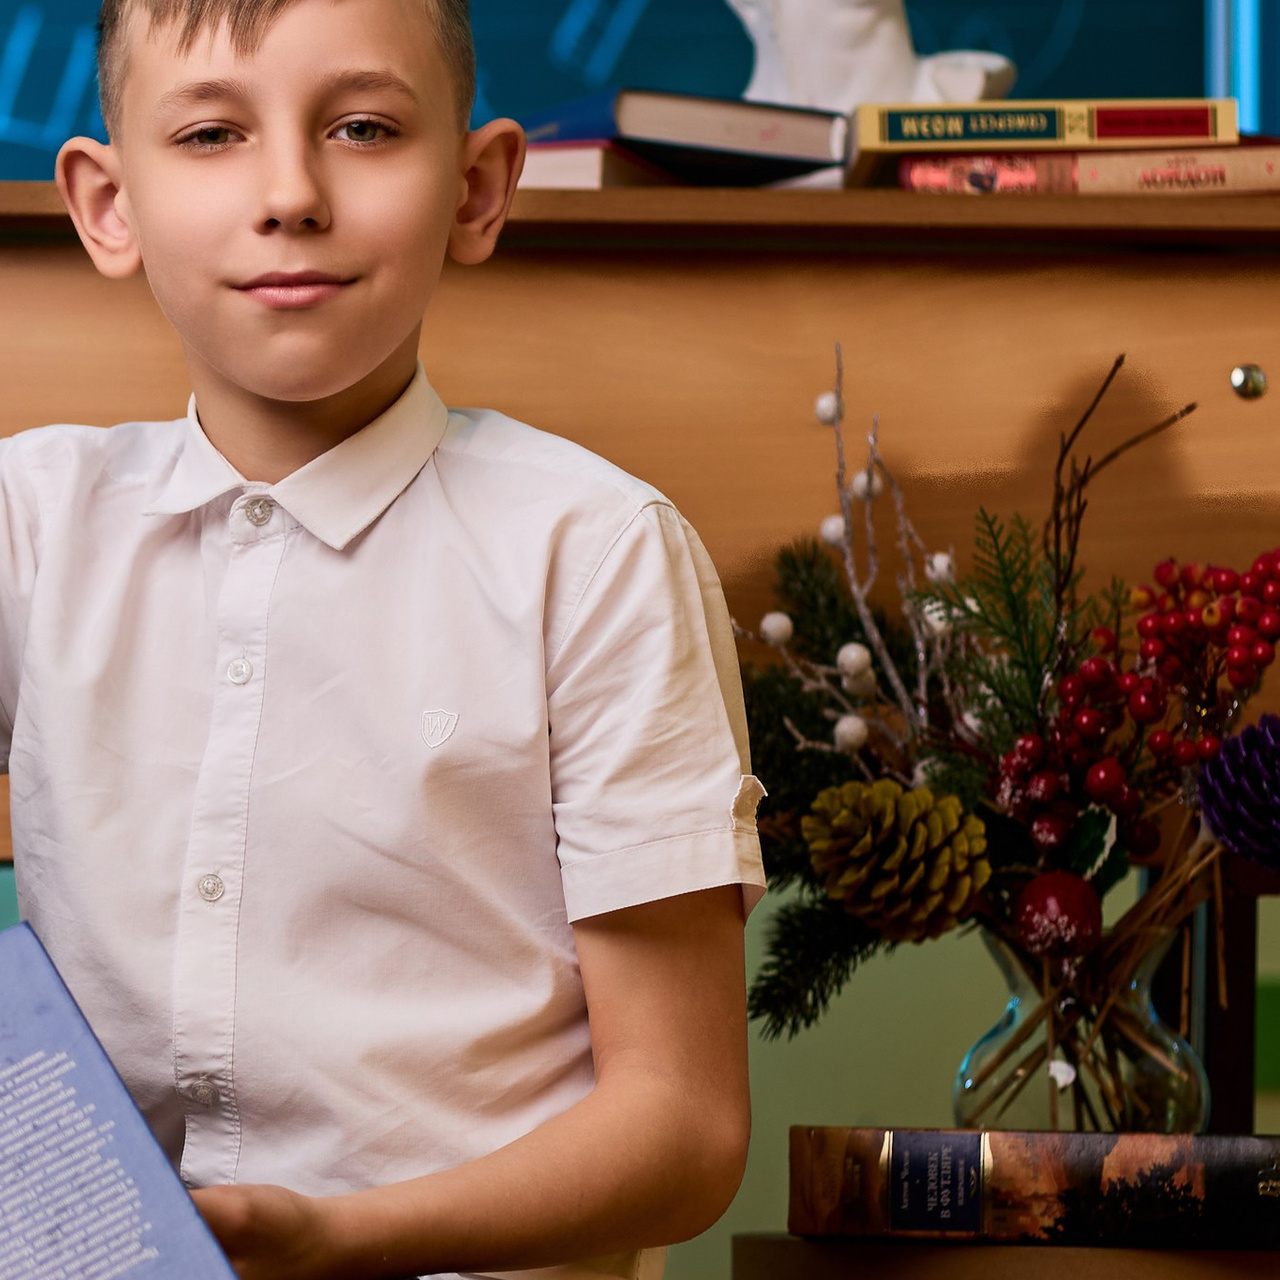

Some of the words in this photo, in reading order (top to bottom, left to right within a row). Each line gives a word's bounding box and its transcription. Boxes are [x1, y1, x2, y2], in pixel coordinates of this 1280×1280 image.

[900, 115, 964, 139] МОЭМ
[428, 716, 451, 738] W
[927, 1150, 939, 1212] ЧЕЛОВЕК
[940, 1143, 952, 1207] ФУТЛЯРЕ
[940, 1209, 952, 1219] В
